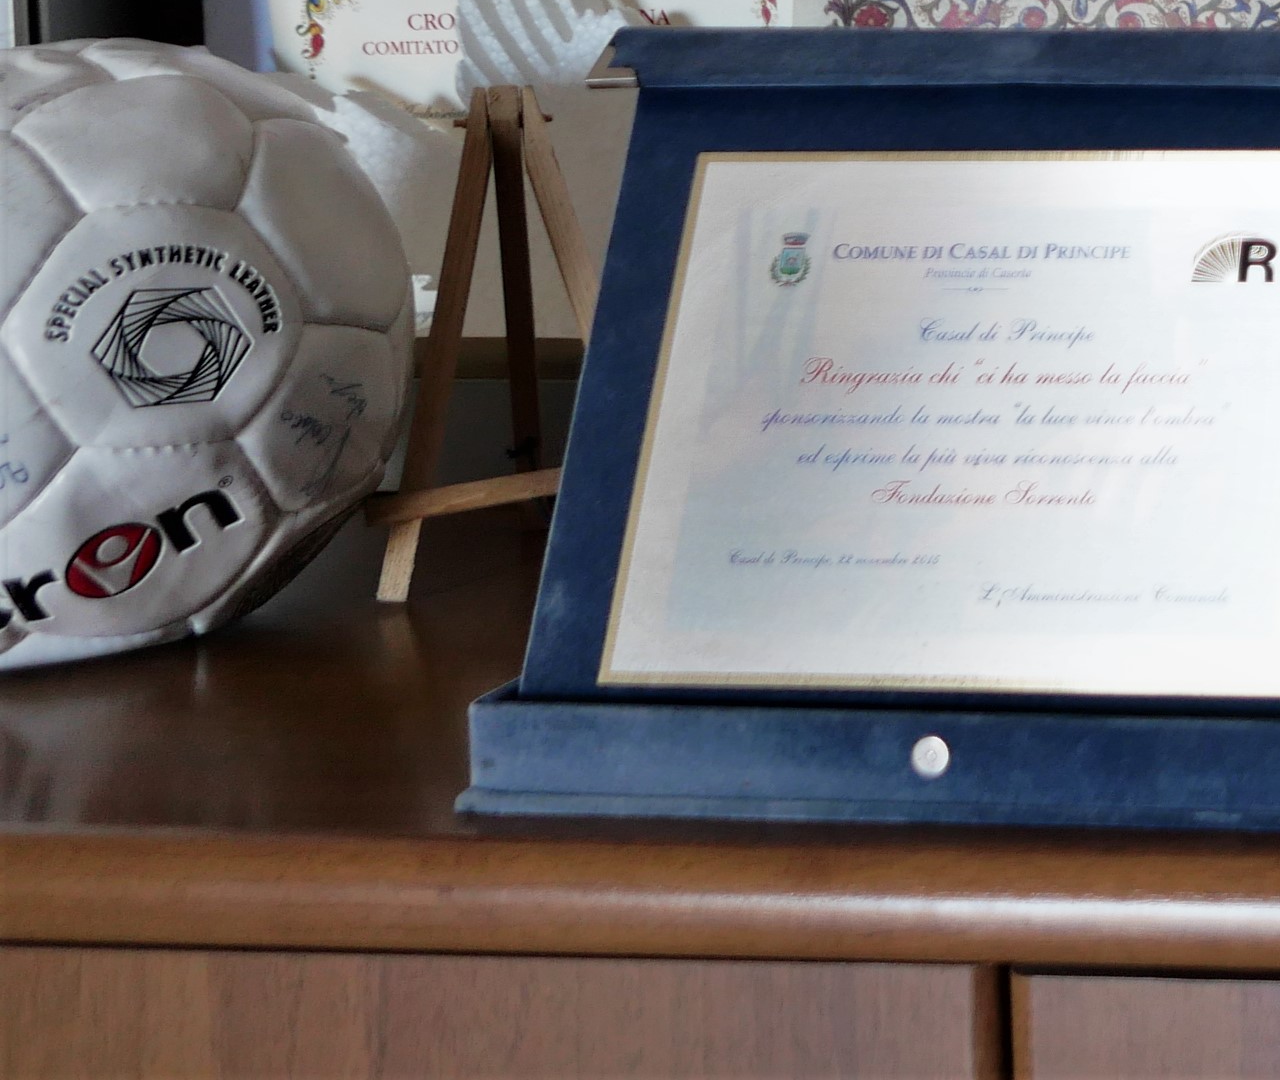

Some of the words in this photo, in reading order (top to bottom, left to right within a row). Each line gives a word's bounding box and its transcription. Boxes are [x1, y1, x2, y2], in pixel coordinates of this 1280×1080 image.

[407, 12, 455, 31] CRO
[362, 39, 459, 57] COMITATO
[1237, 239, 1278, 282] R
[45, 269, 111, 342] SPECIAL
[109, 245, 228, 278] SYNTHETIC
[229, 260, 282, 336] LEATHER
